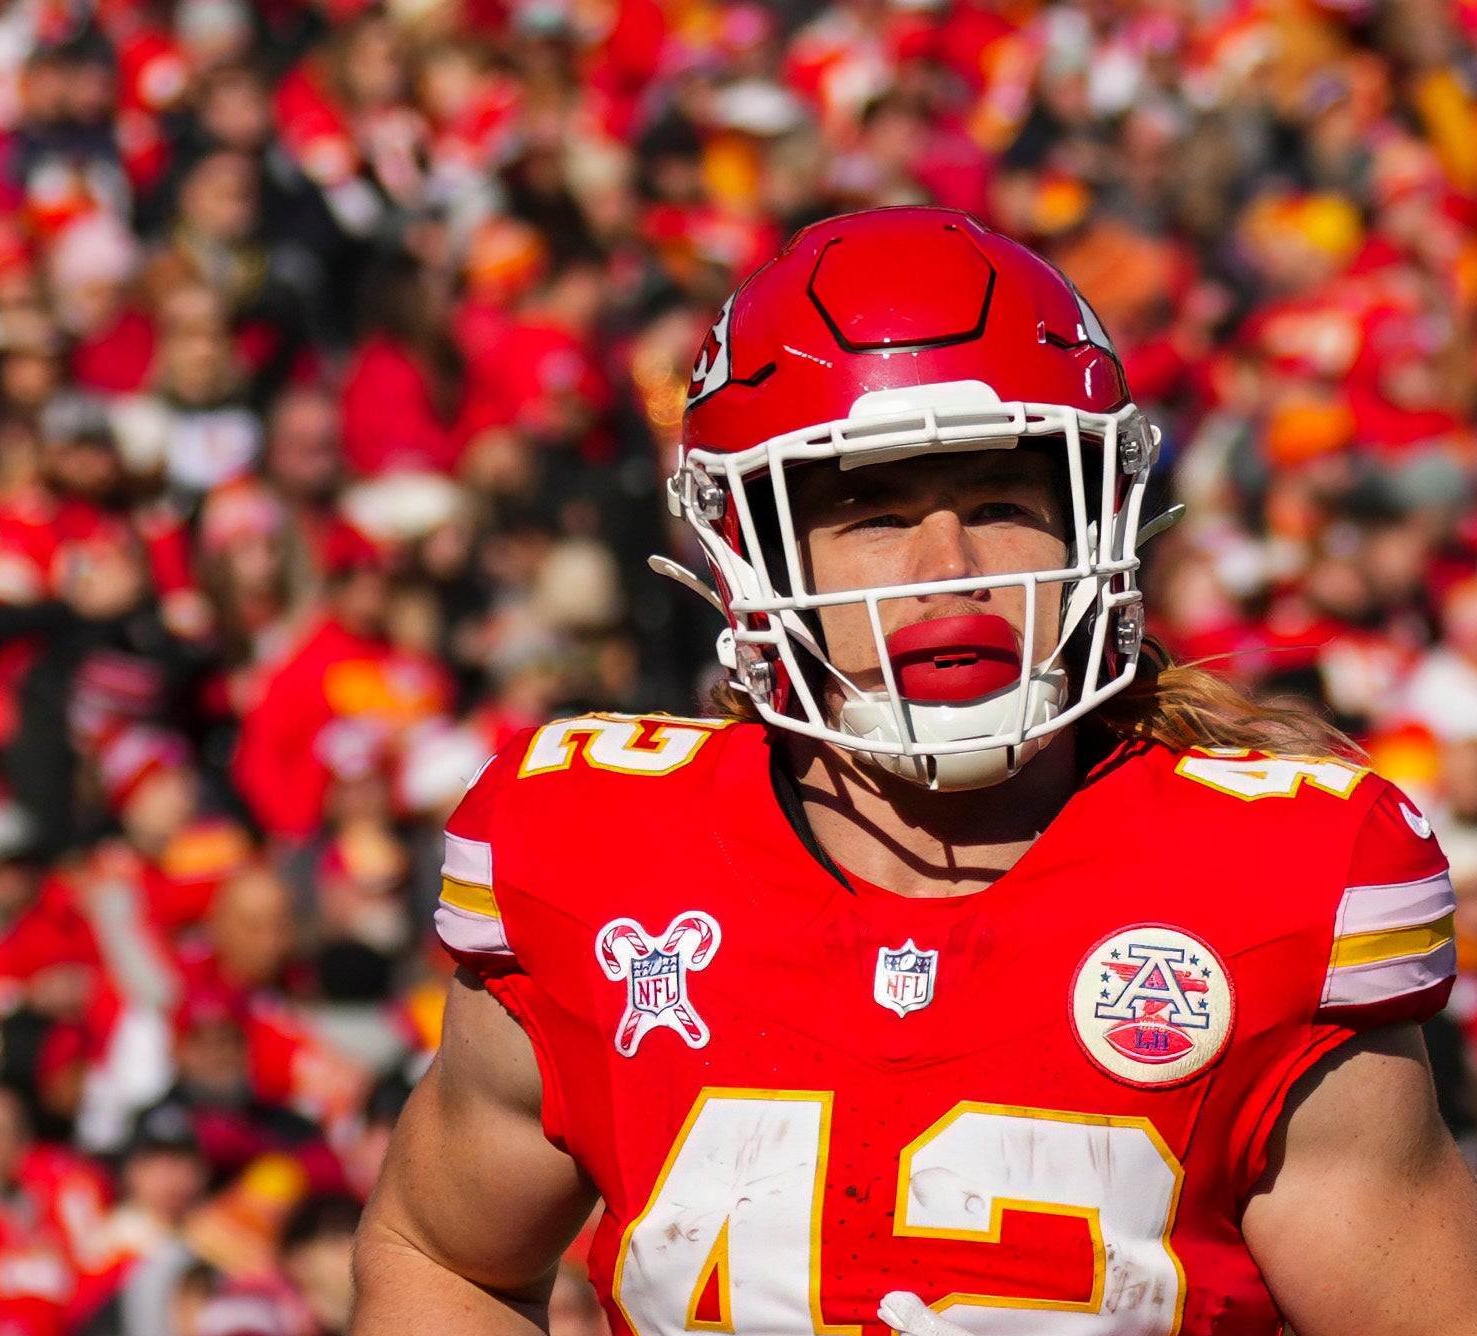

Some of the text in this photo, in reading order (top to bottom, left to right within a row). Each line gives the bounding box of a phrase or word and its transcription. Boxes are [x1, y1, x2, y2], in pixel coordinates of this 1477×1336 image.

[517, 711, 737, 779] 2
[1174, 745, 1374, 802] 4
[636, 976, 677, 1007] NFL
[886, 974, 924, 1000] NFL
[1095, 944, 1210, 1029] A
